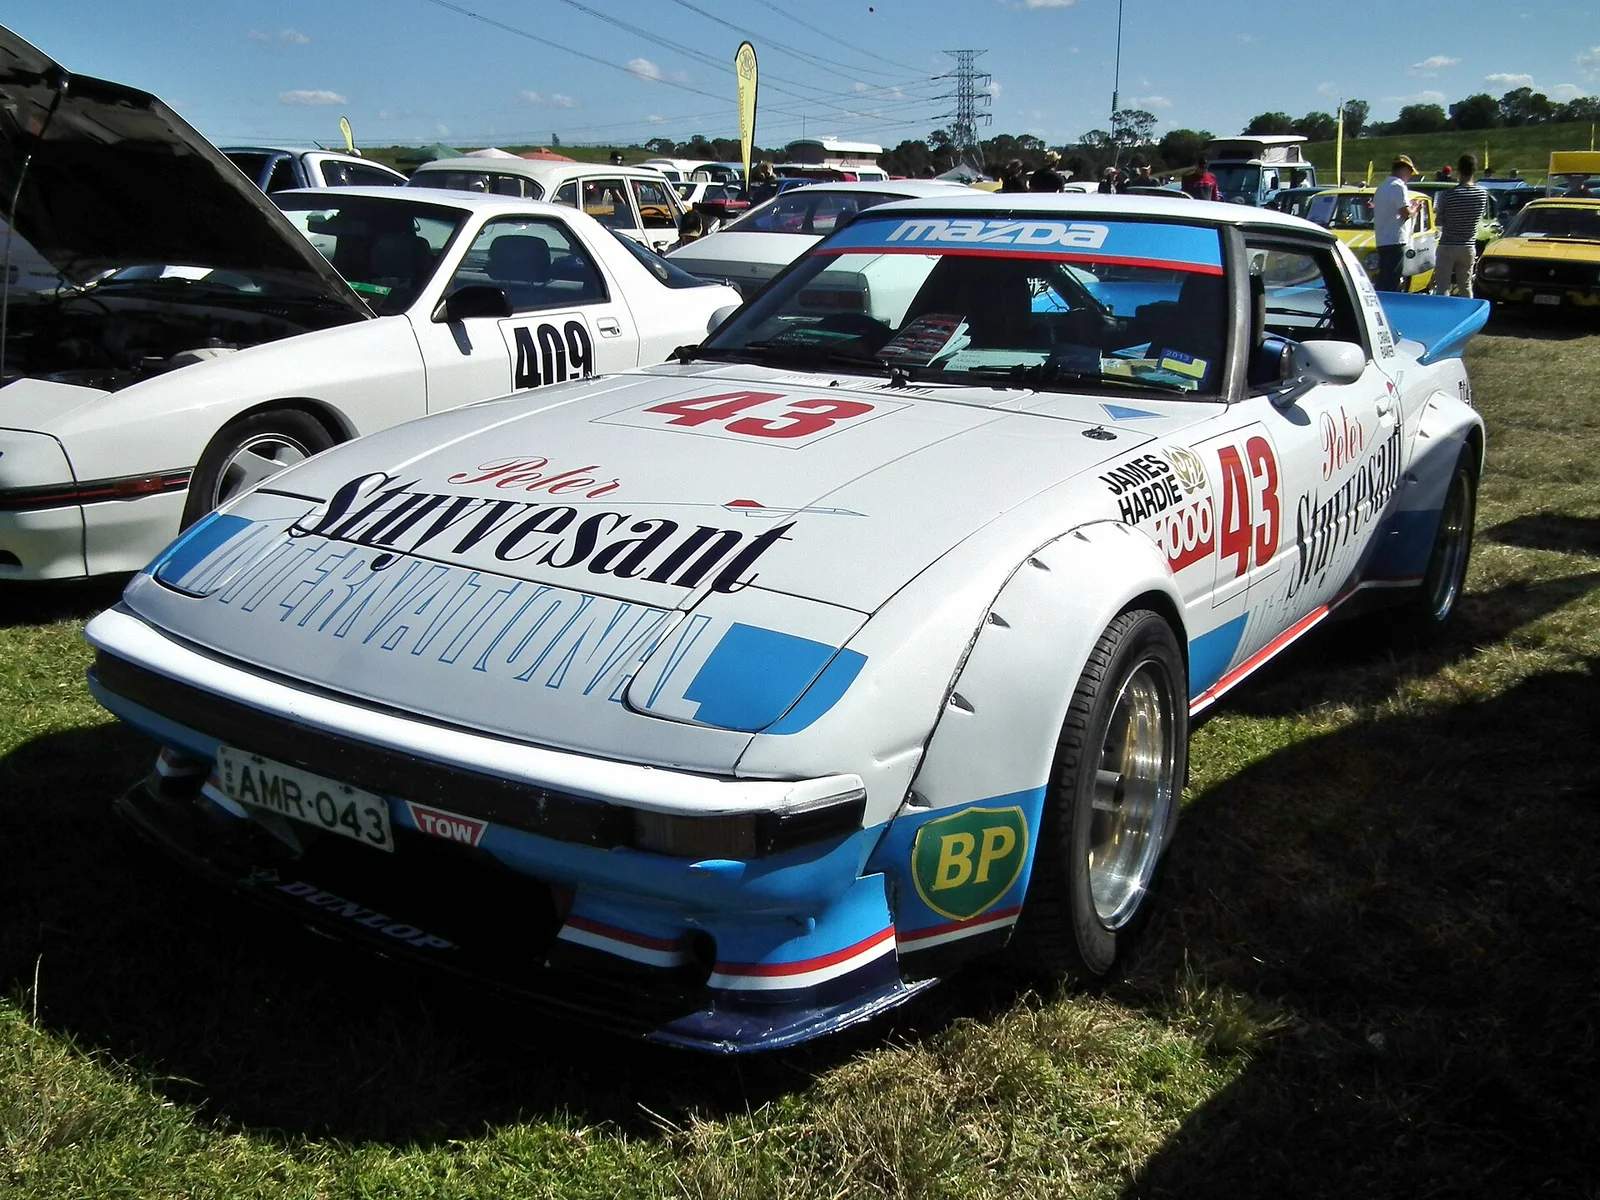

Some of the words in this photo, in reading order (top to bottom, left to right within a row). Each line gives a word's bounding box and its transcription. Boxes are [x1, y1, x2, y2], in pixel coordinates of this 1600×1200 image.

[514, 320, 592, 389] 409
[642, 390, 875, 438] 43
[1320, 406, 1363, 481] Peter
[447, 455, 620, 499] Peter
[1098, 454, 1170, 495] JAMES
[1117, 474, 1183, 526] HARDIE
[1217, 435, 1280, 578] 43
[289, 471, 797, 595] Stuyvesant
[177, 522, 703, 718] INTERNATIONAL
[421, 814, 473, 844] TOW
[934, 825, 1016, 891] BP
[275, 880, 457, 950] DUNLOP
